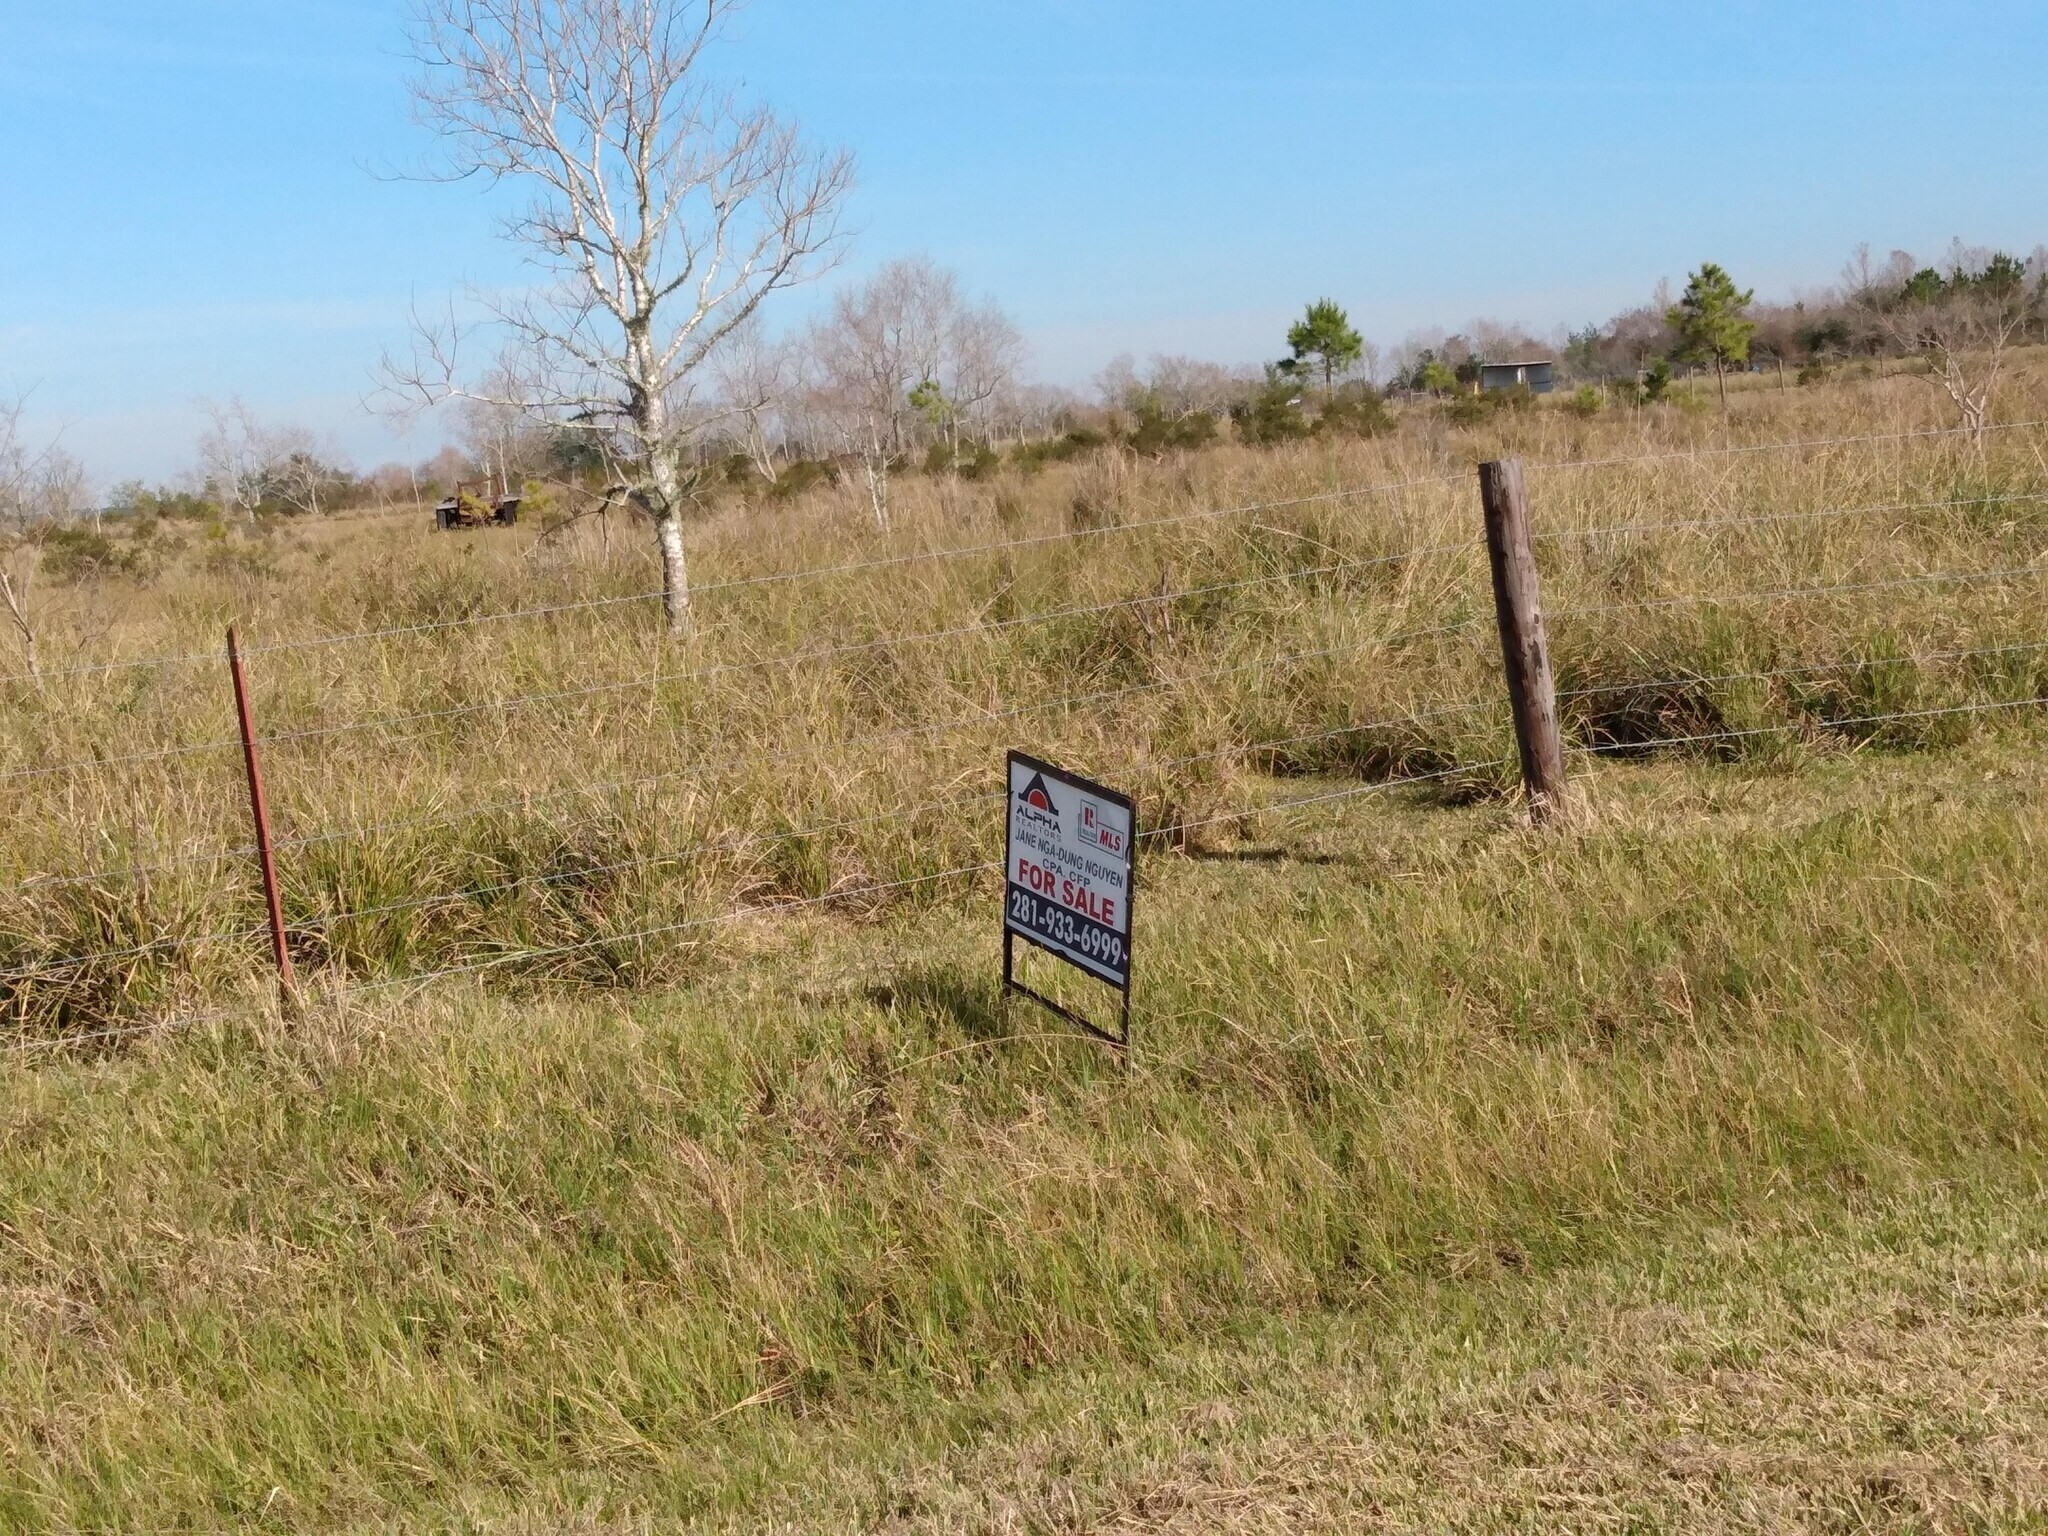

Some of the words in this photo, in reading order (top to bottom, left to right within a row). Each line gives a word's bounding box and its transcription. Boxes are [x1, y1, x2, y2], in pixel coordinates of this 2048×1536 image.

[1015, 815, 1062, 842] REALTORS
[1016, 804, 1061, 834] ALPHA
[1099, 830, 1121, 851] MLS
[1015, 828, 1036, 848] JANE
[1038, 839, 1083, 870] NGA-DUNG
[1085, 860, 1123, 888] NGUYEN
[1019, 858, 1056, 899] FOR
[1062, 880, 1114, 926] SALE
[1069, 871, 1091, 887] CFP
[1011, 890, 1121, 966] 281-933-6999
